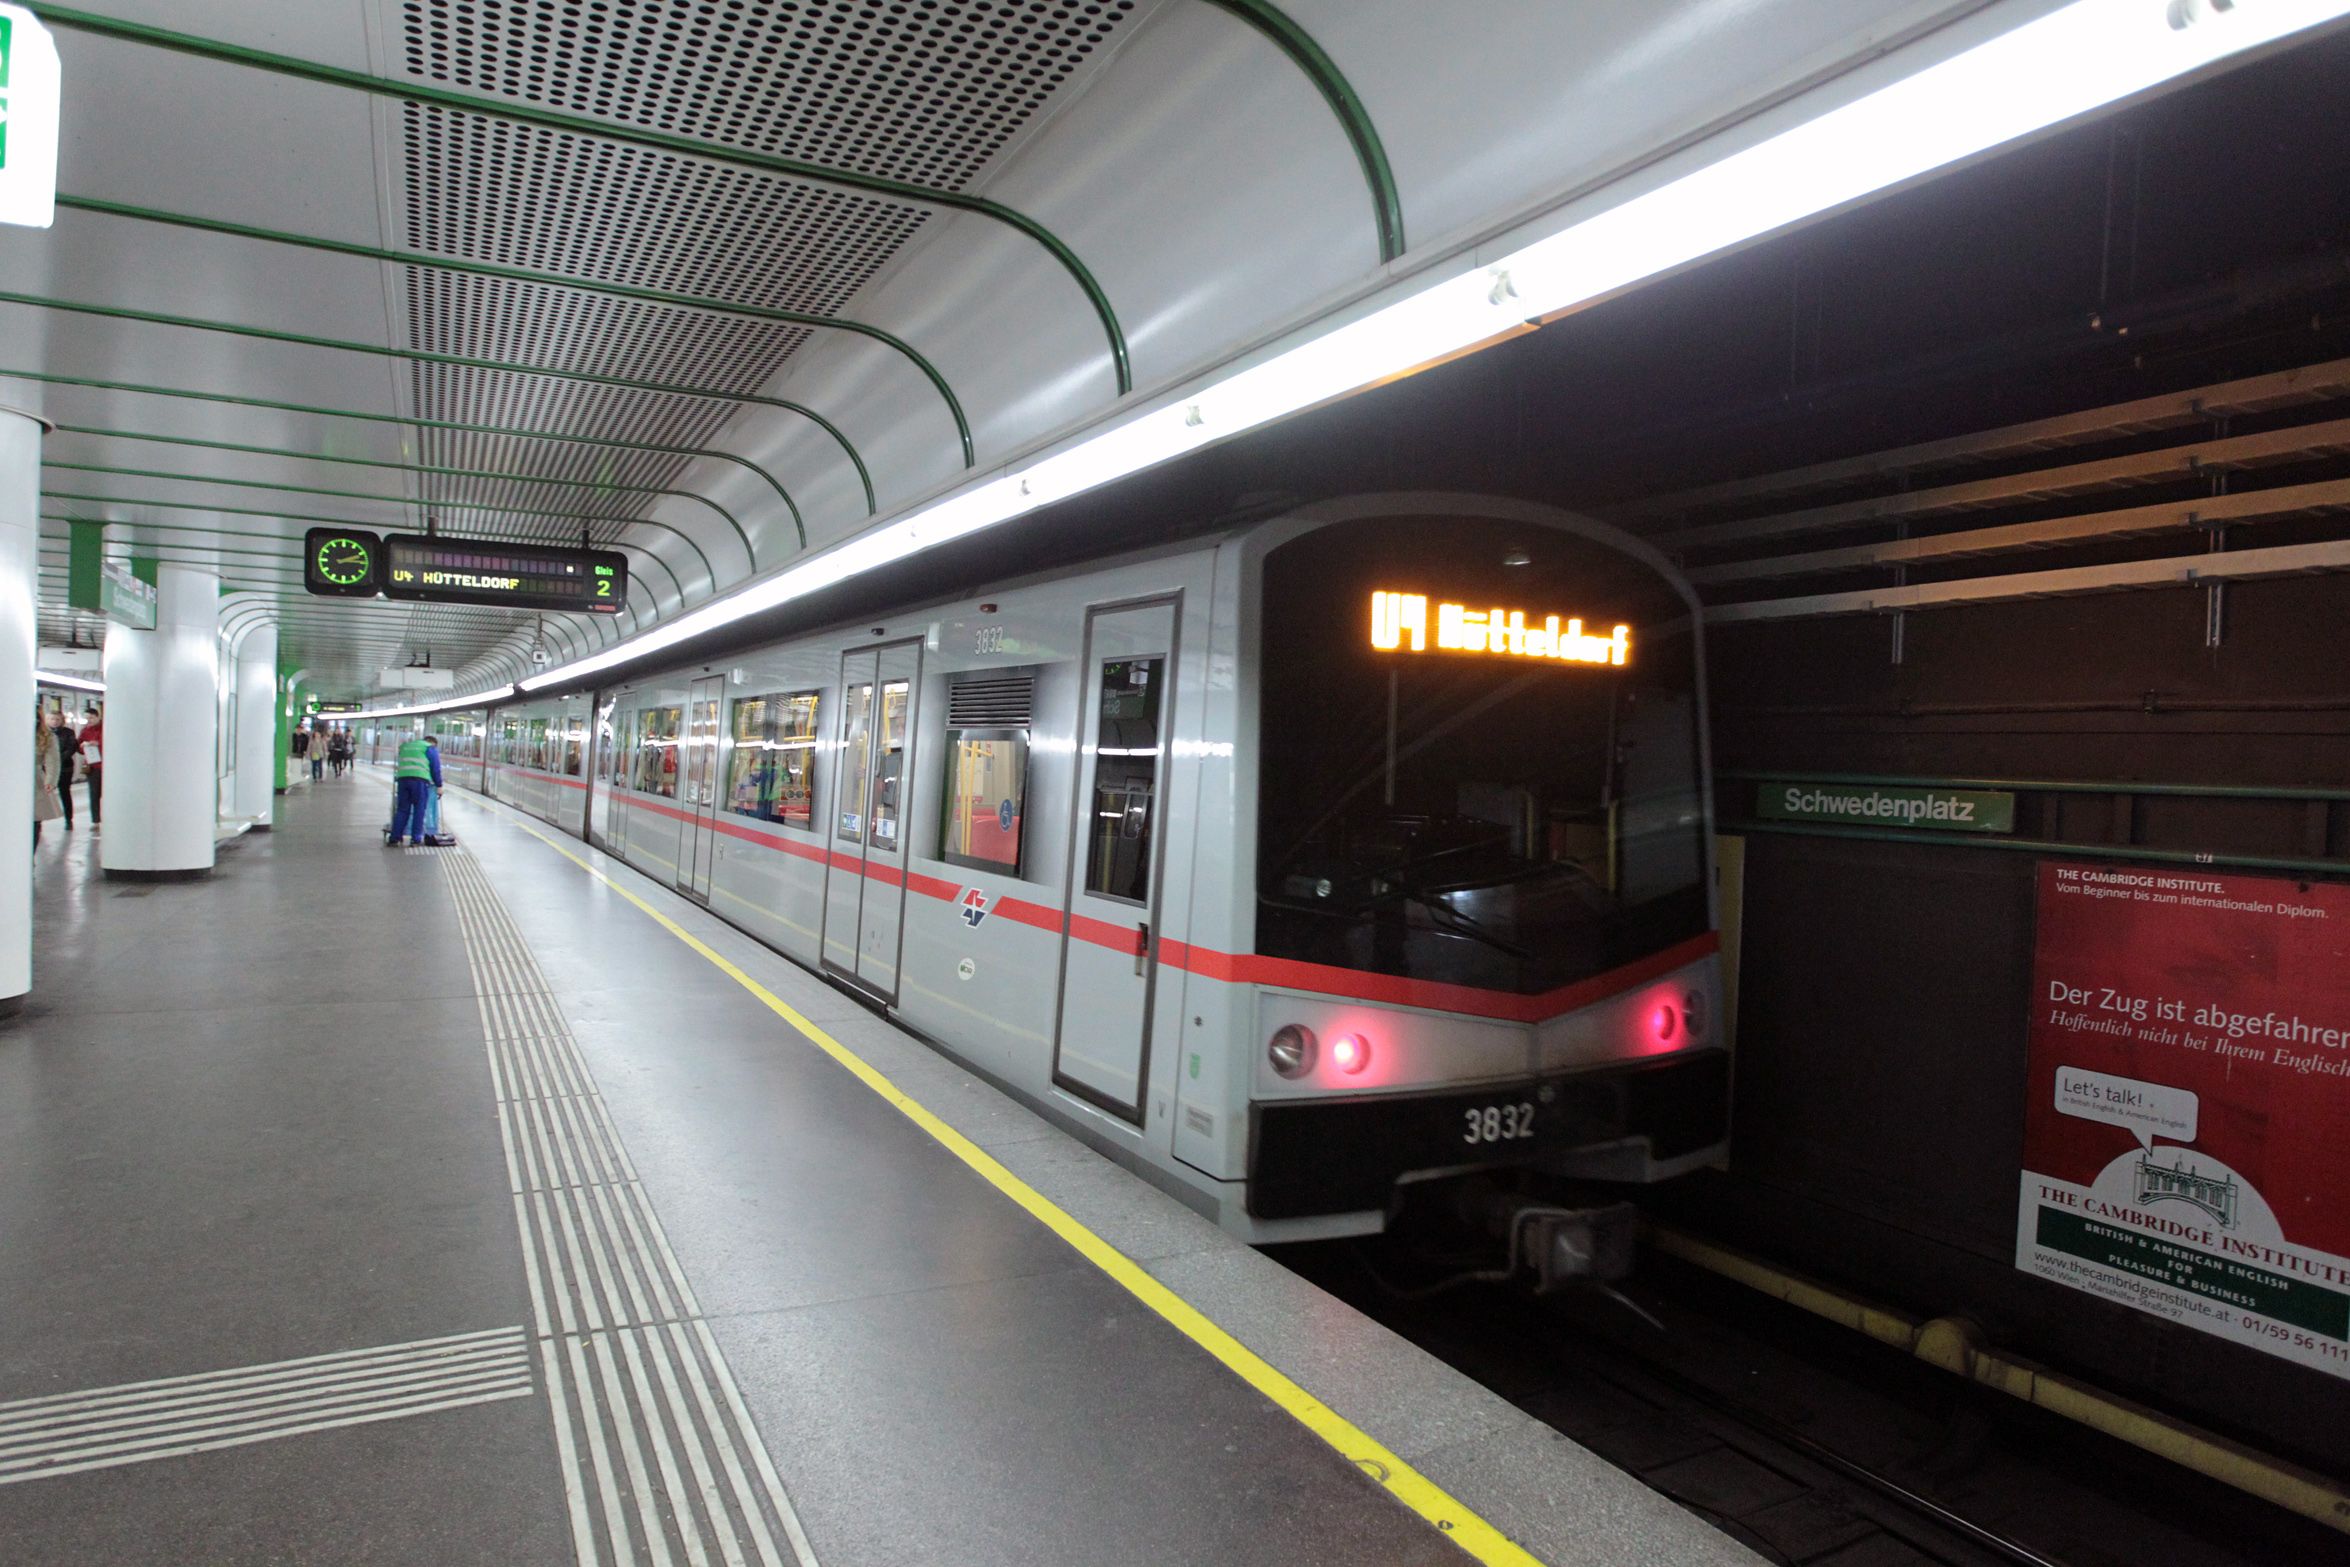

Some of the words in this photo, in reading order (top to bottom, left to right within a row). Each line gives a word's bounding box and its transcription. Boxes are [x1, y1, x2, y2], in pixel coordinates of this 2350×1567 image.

[393, 569, 414, 582] U4
[423, 572, 520, 590] HÜTTELDORF
[594, 565, 614, 576] Gleis
[597, 580, 611, 596] 2
[974, 626, 1004, 655] 3832
[1784, 787, 1975, 823] Schwedenplatz
[2057, 868, 2079, 880] THE
[2081, 871, 2154, 887] CAMBRIDGE
[2157, 878, 2225, 894] INSTITUTE.
[2056, 882, 2080, 893] Vom
[2083, 885, 2131, 899] Beginner
[2134, 889, 2150, 901] bis
[2152, 893, 2177, 904] zum
[2181, 895, 2273, 913] internationalen
[2277, 903, 2329, 919] Diplom.
[2049, 980, 2093, 1006] Der
[2099, 988, 2149, 1021] Zug
[2156, 997, 2186, 1022] ist
[2050, 1009, 2132, 1037] Hoffentlich
[2138, 1026, 2178, 1045] nicht
[2183, 1032, 2208, 1051] bei
[2214, 1038, 2266, 1062] Ihrem
[2064, 1078, 2100, 1098] Let's
[2106, 1086, 2142, 1107] talk!
[1463, 1102, 1535, 1144] 3832
[2039, 1185, 2078, 1207] THE
[2084, 1198, 2213, 1246] CAMBRIDGE
[2084, 1223, 2133, 1244] BRITISH
[2138, 1239, 2148, 1248] &
[2153, 1243, 2223, 1271] AMERICAN
[2228, 1265, 2290, 1290] ENGLISH
[2168, 1260, 2193, 1274] FOR
[2058, 1272, 2080, 1284] Wien
[2170, 1309, 2184, 1319] 97
[2108, 1254, 2171, 1280] PLEASURE
[2176, 1275, 2186, 1285] &
[2191, 1280, 2256, 1307] BUSINESS
[2034, 1252, 2229, 1322] www.thecambridgeinstitute.at
[2242, 1316, 2290, 1341] 01/59
[2294, 1333, 2314, 1349] 56
